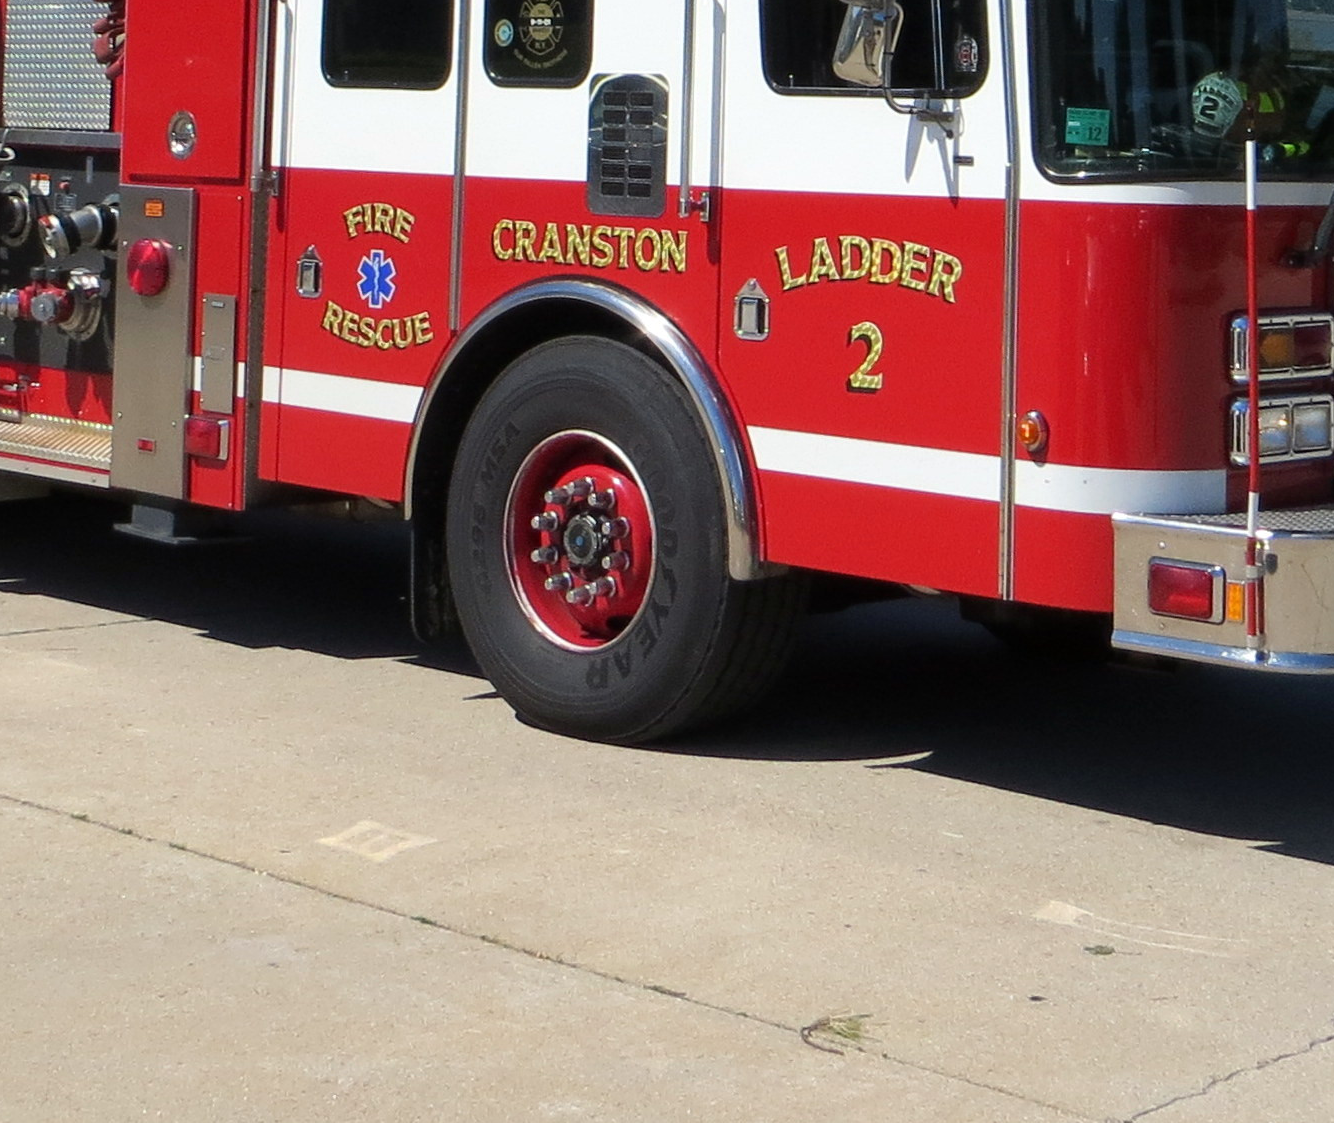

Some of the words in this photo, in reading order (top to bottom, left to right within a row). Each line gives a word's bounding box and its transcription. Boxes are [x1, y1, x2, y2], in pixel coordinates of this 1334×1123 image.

[1087, 126, 1102, 141] 12
[1199, 96, 1220, 121] 2
[344, 202, 415, 244] FIRE
[493, 219, 689, 273] CRANSTON
[775, 235, 963, 303] LADDER
[322, 301, 434, 351] RESCUE
[847, 321, 884, 391] 2
[584, 442, 679, 690] GOODYEAR
